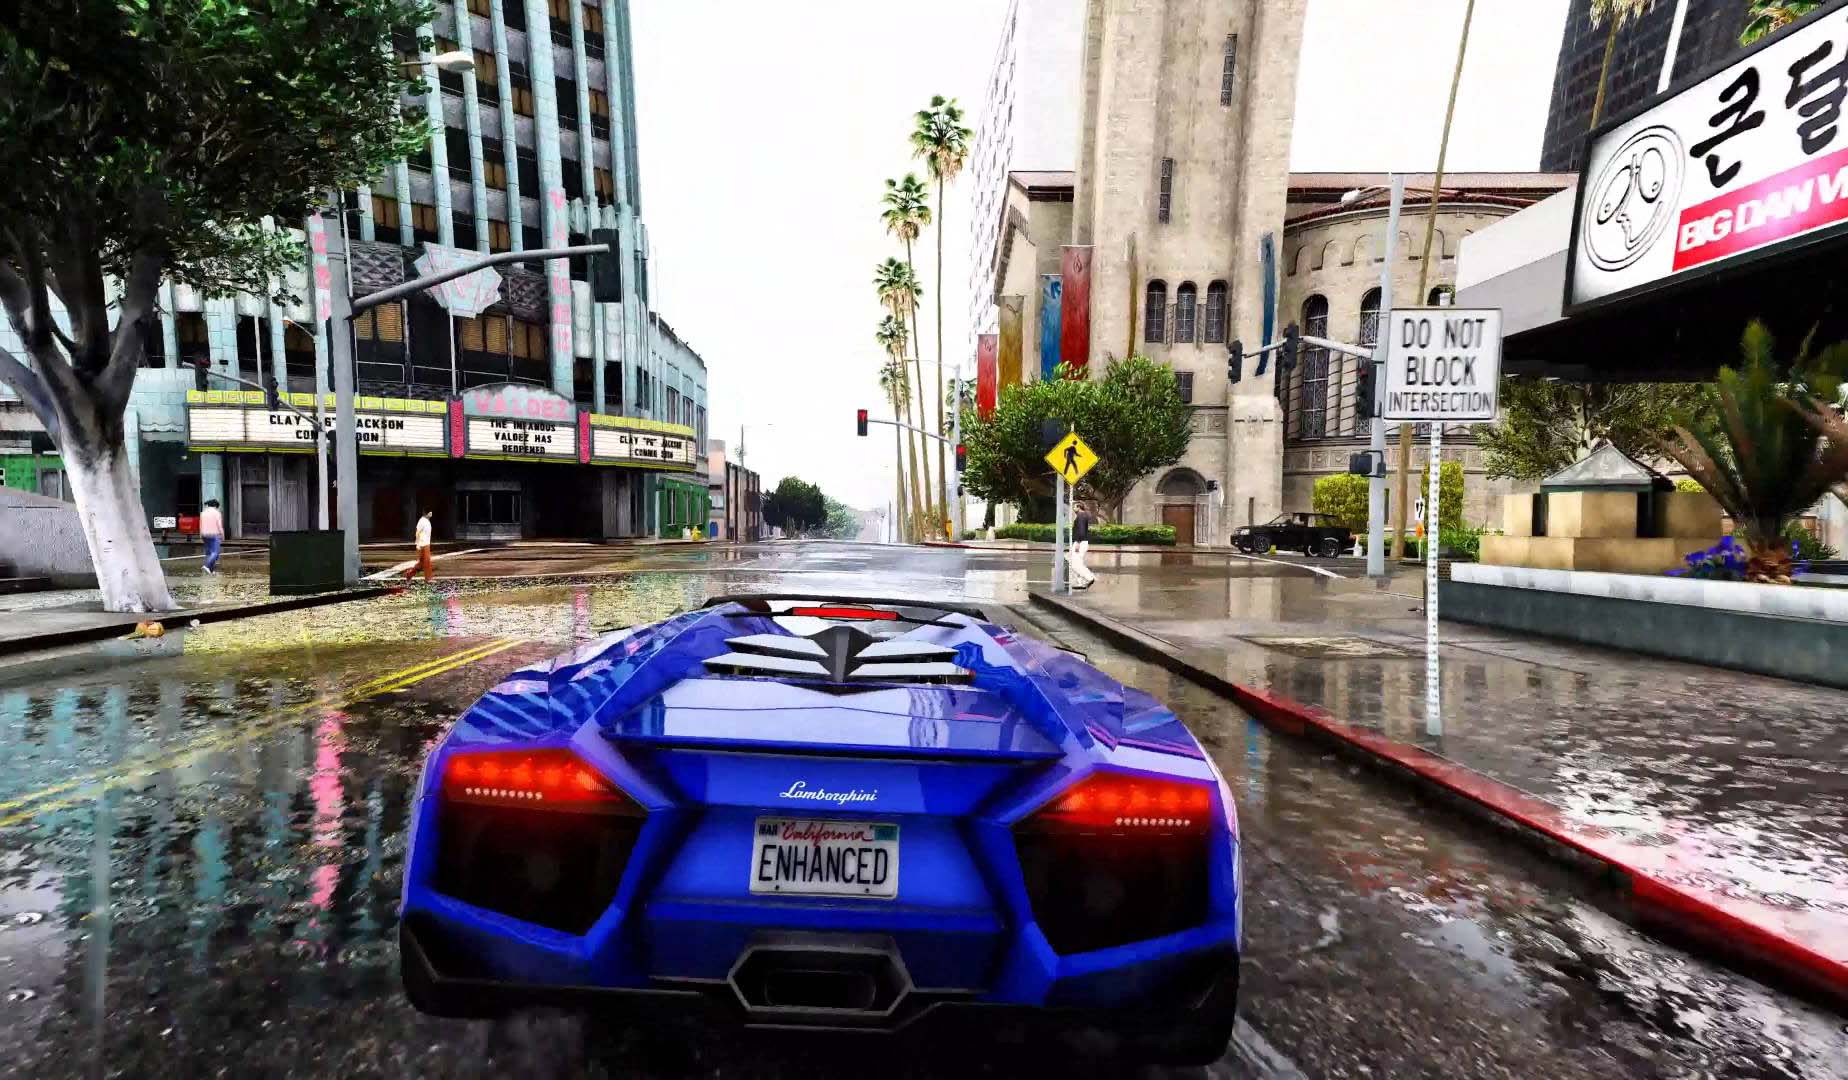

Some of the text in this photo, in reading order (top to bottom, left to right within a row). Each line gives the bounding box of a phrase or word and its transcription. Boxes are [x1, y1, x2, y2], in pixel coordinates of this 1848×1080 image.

[1678, 208, 1734, 253] BIG
[1734, 177, 1816, 234] DAN
[1402, 318, 1487, 349] DO NOT
[1405, 355, 1477, 387] BLOCK
[474, 388, 569, 419] VALDEZ
[1388, 391, 1492, 413] INTERSECTION
[269, 414, 301, 425] CLAY
[356, 418, 404, 430] ACKSON
[490, 418, 508, 429] THE
[494, 431, 552, 444] VALDEZ HAS
[502, 444, 546, 455] REOPENED
[619, 435, 639, 445] CLAY
[779, 780, 878, 805] Lamborghini
[782, 821, 874, 848] California
[758, 844, 889, 886] ENHANCED
